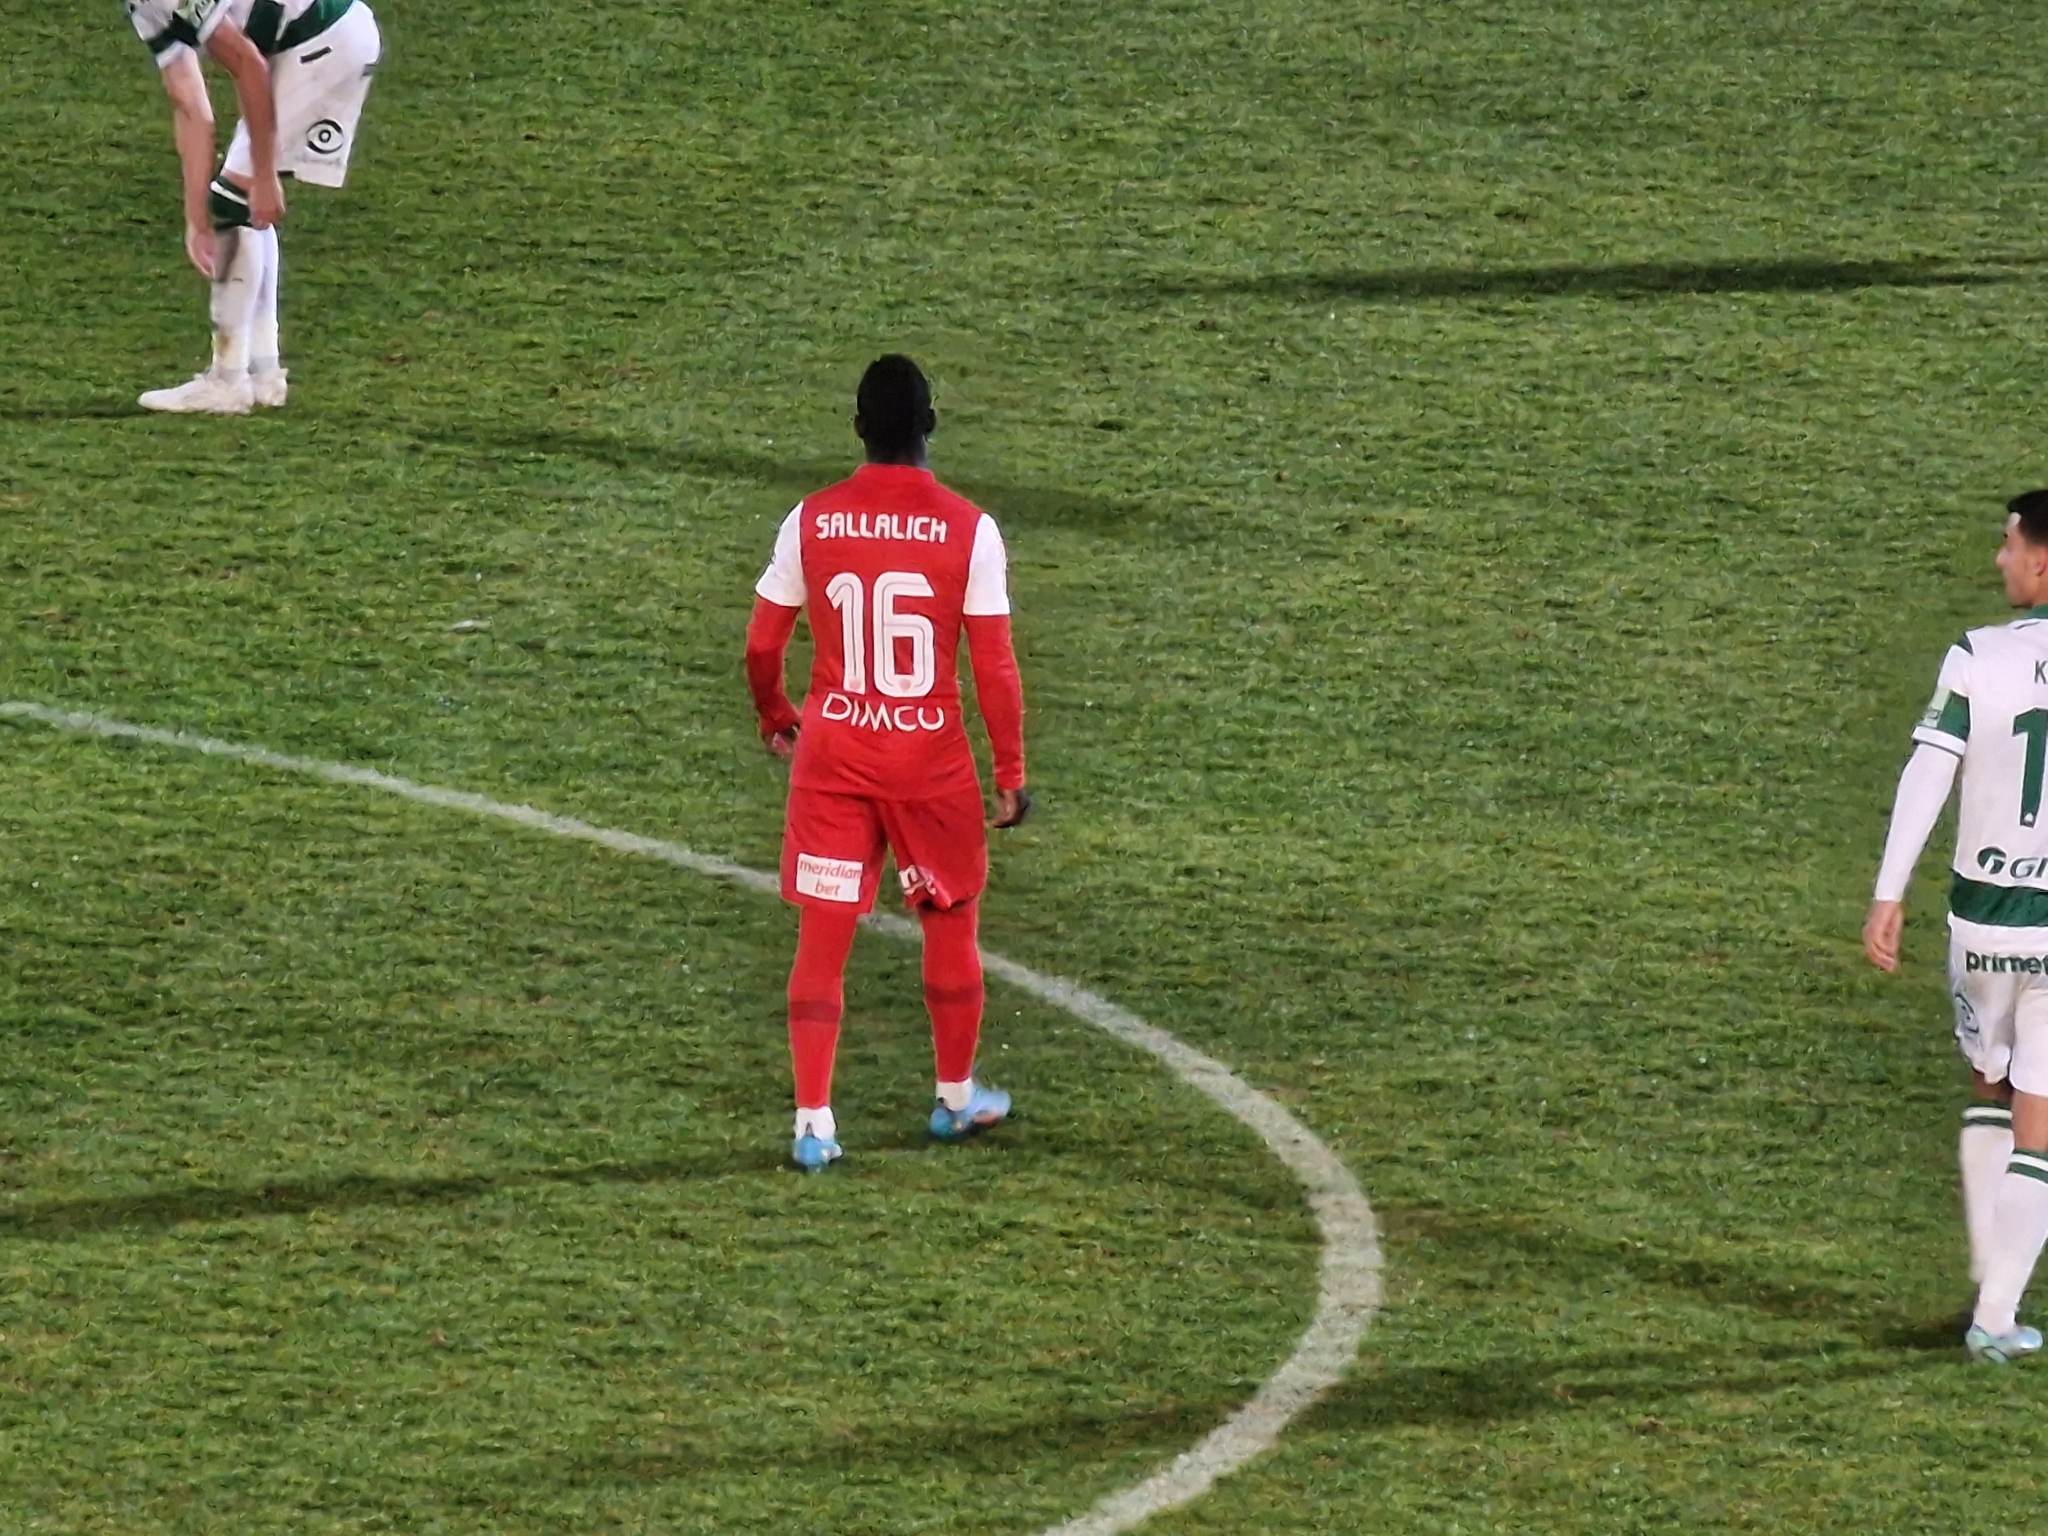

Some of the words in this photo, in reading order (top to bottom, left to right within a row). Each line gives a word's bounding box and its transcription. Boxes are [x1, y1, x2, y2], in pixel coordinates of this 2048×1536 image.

[815, 511, 948, 544] SALLALICH
[824, 571, 936, 698] 16
[799, 859, 863, 880] meridian
[814, 879, 841, 898] bet
